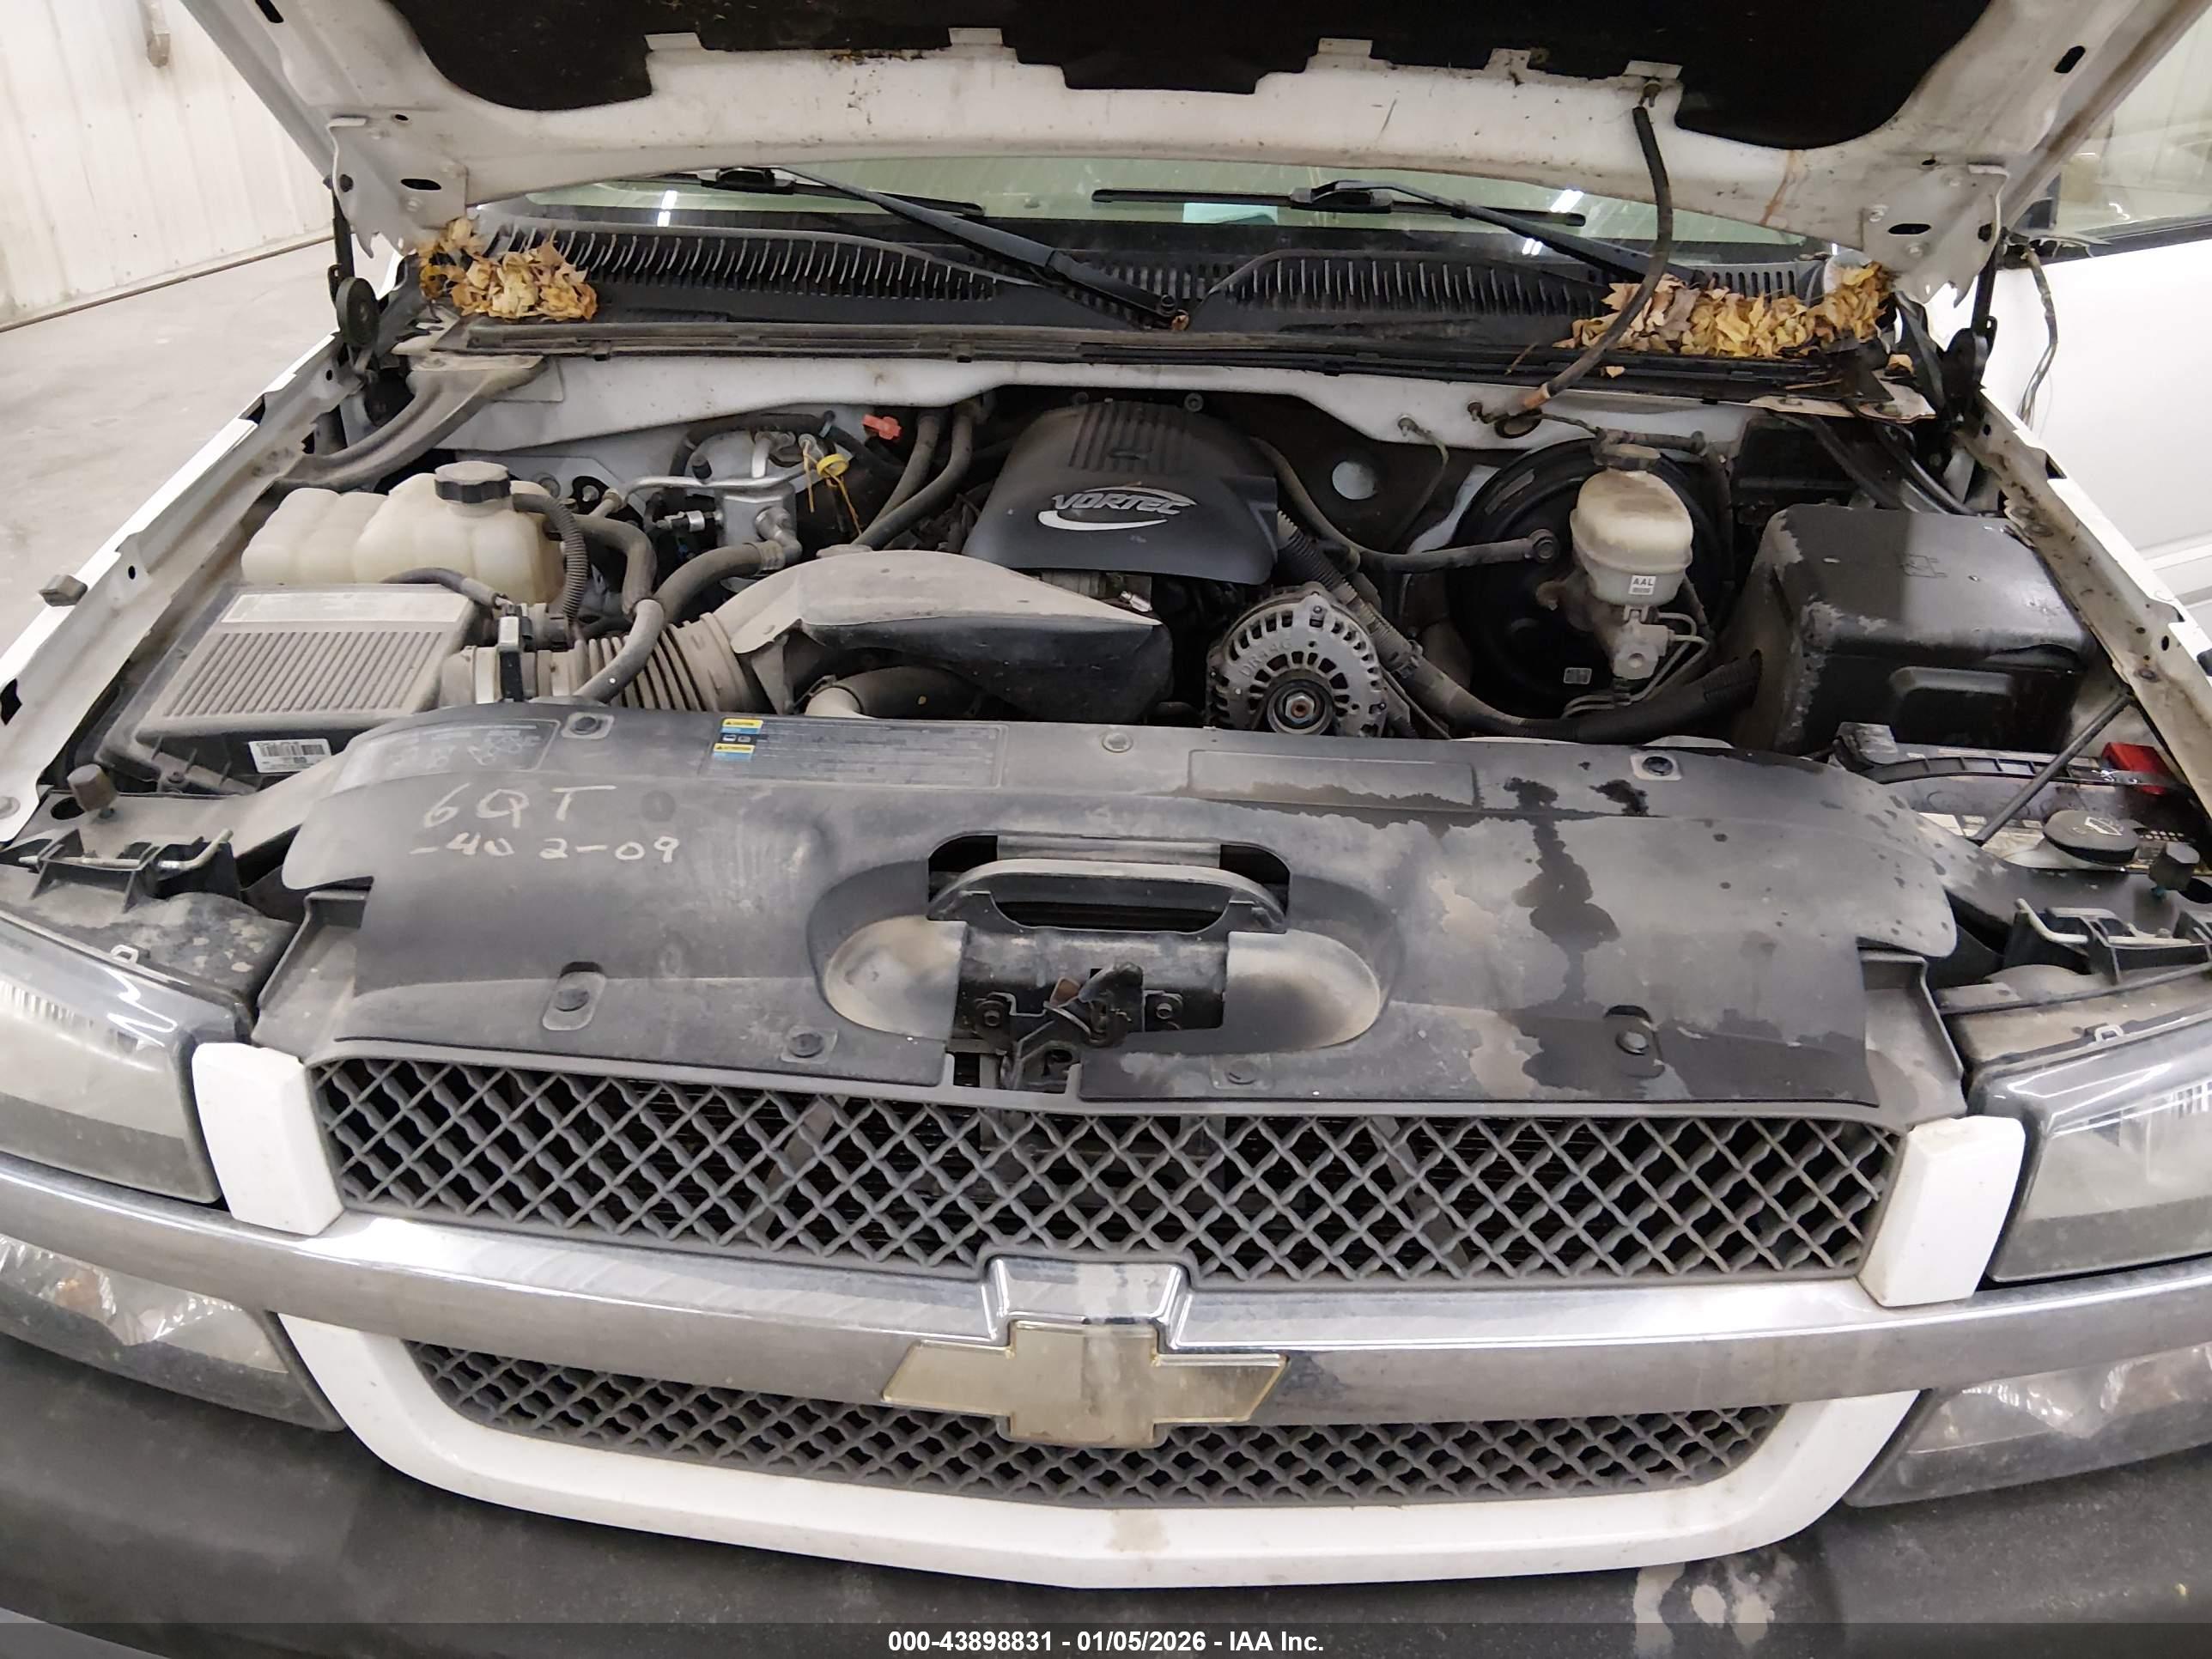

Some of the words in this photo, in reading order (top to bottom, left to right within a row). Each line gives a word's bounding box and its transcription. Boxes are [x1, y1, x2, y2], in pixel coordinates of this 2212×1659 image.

[1052, 492, 1191, 515] VORTEC
[1632, 577, 1654, 586] AAL
[539, 836, 680, 863] 2-09
